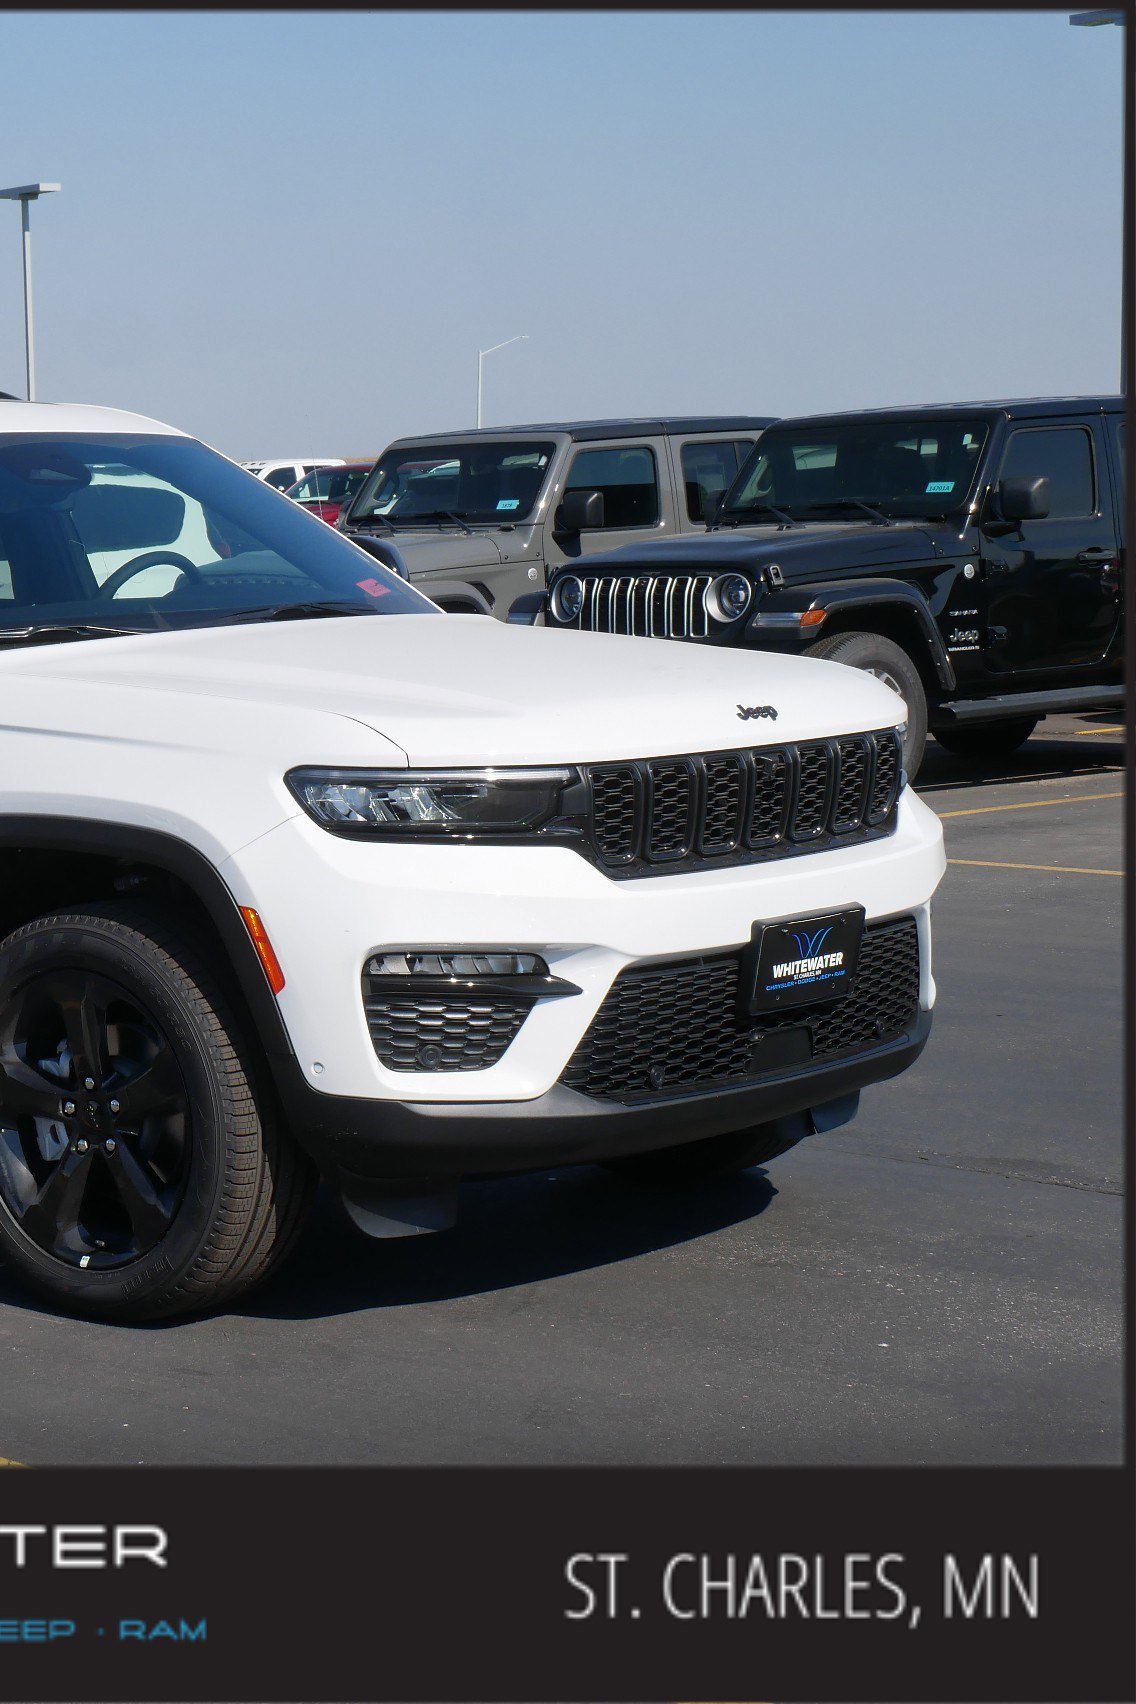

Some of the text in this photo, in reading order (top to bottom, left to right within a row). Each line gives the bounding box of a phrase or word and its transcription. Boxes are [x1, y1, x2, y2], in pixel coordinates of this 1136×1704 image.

[949, 628, 979, 643] Jeep
[736, 704, 778, 721] Jeep
[773, 952, 843, 978] WHITEWATER
